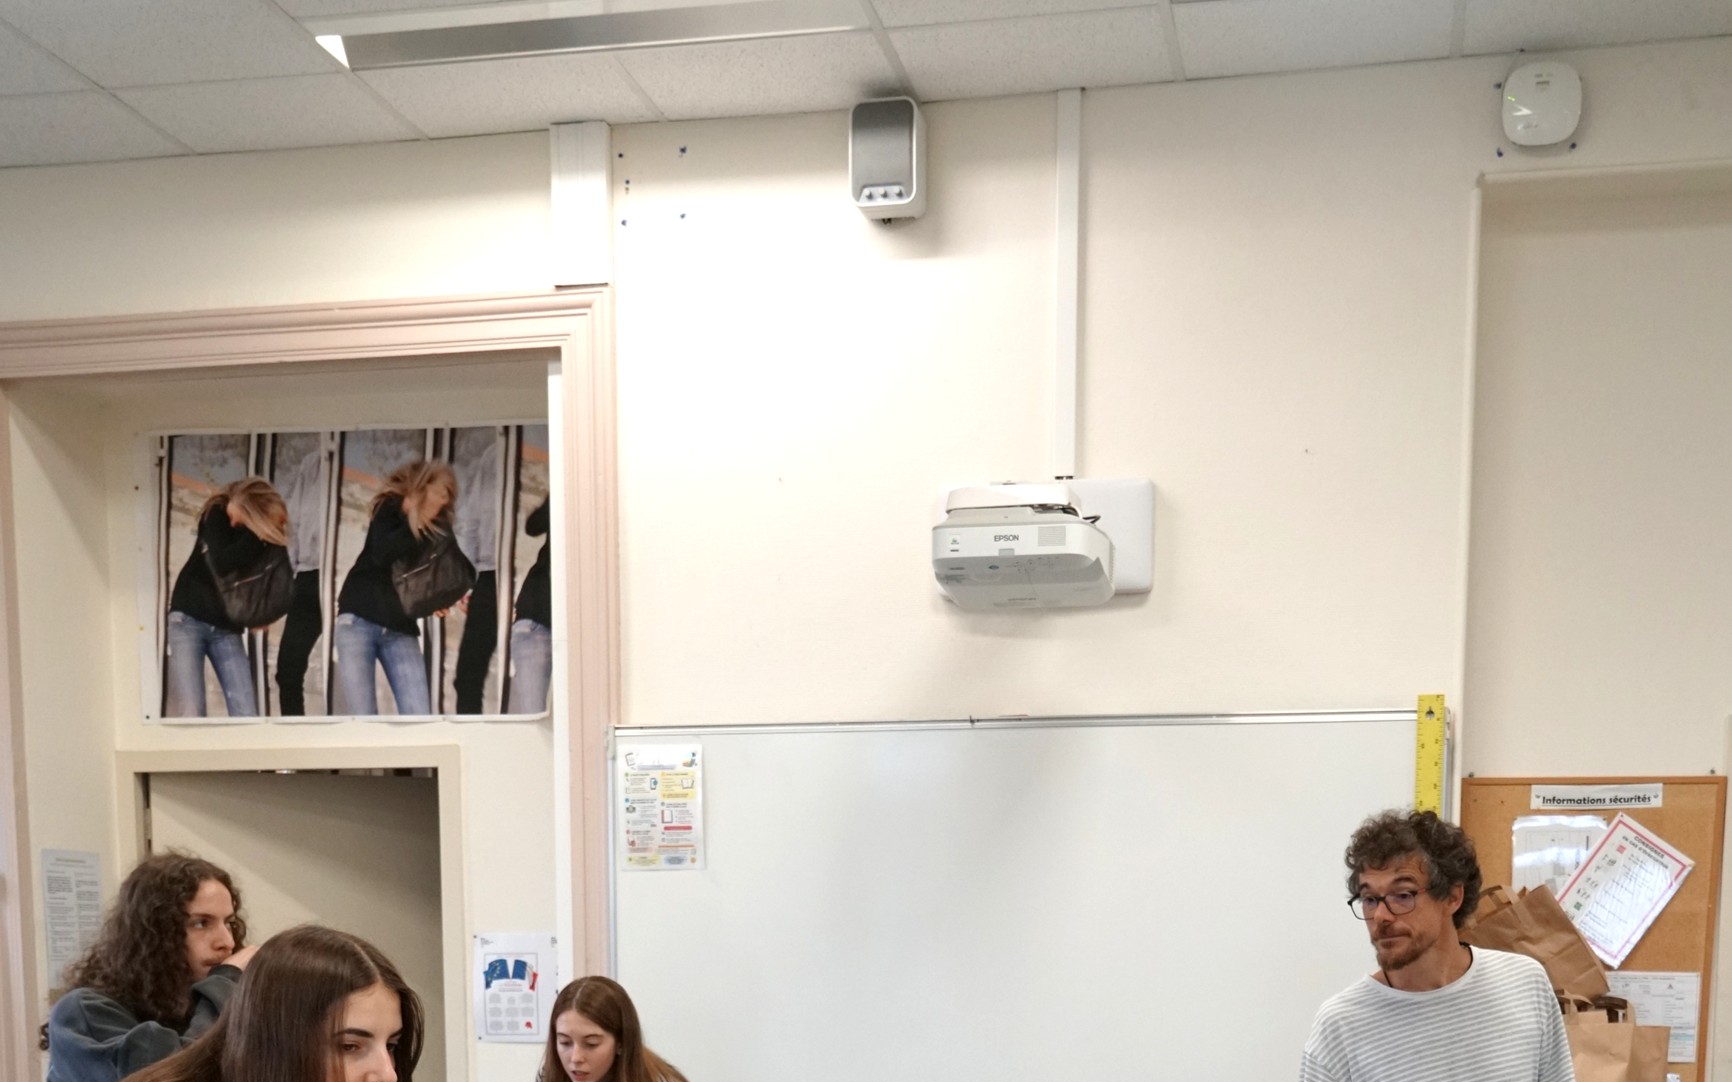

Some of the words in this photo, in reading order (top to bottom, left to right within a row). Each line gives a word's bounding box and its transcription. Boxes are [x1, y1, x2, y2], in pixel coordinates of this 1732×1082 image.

[994, 534, 1019, 542] EPSON
[1542, 796, 1606, 805] Informations
[1609, 794, 1651, 804] sécurités
